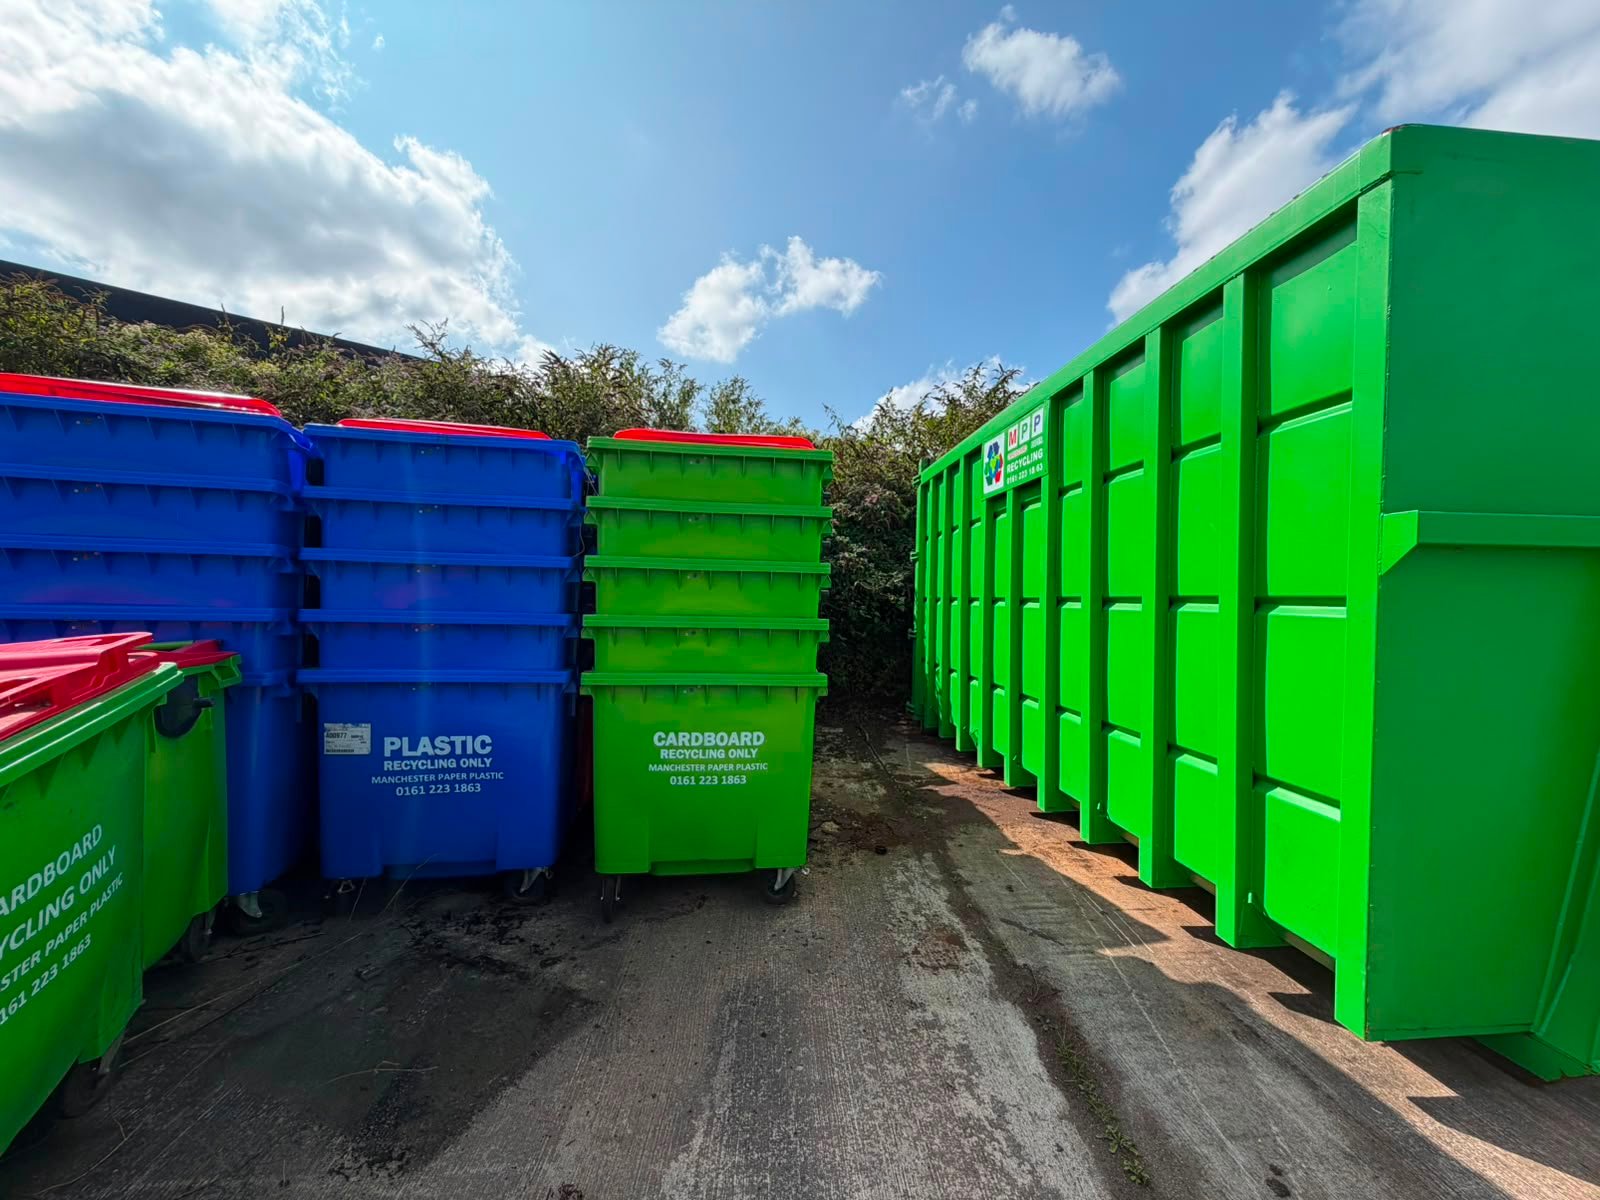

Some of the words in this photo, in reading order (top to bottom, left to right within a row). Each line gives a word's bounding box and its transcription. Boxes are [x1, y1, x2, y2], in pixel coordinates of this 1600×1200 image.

[1006, 448, 1043, 474] RECYCLING
[384, 735, 492, 757] PLASTIC
[653, 731, 765, 747] CARDBOARD
[660, 748, 725, 760] RECYCLING
[728, 747, 758, 759] ONLY
[384, 759, 456, 771] RECYCLING
[460, 757, 492, 768] ONLY
[648, 763, 706, 772] MANCHESTER
[708, 763, 734, 772] PAPER
[736, 762, 768, 771] PLASTIC
[371, 774, 436, 784] MANCHESTER
[438, 772, 467, 781] PAPER
[469, 771, 504, 780] PLASTIC
[670, 776, 696, 785] 0161
[699, 775, 718, 785] 223
[721, 774, 747, 785] 1863
[396, 786, 425, 796] 0161
[429, 784, 450, 794] 223
[454, 783, 481, 793] 1863
[79, 844, 116, 895] ONLY
[45, 911, 88, 957] PAPER
[90, 872, 123, 918] PLASTIC
[31, 963, 58, 997] 223
[62, 933, 92, 970] 1863
